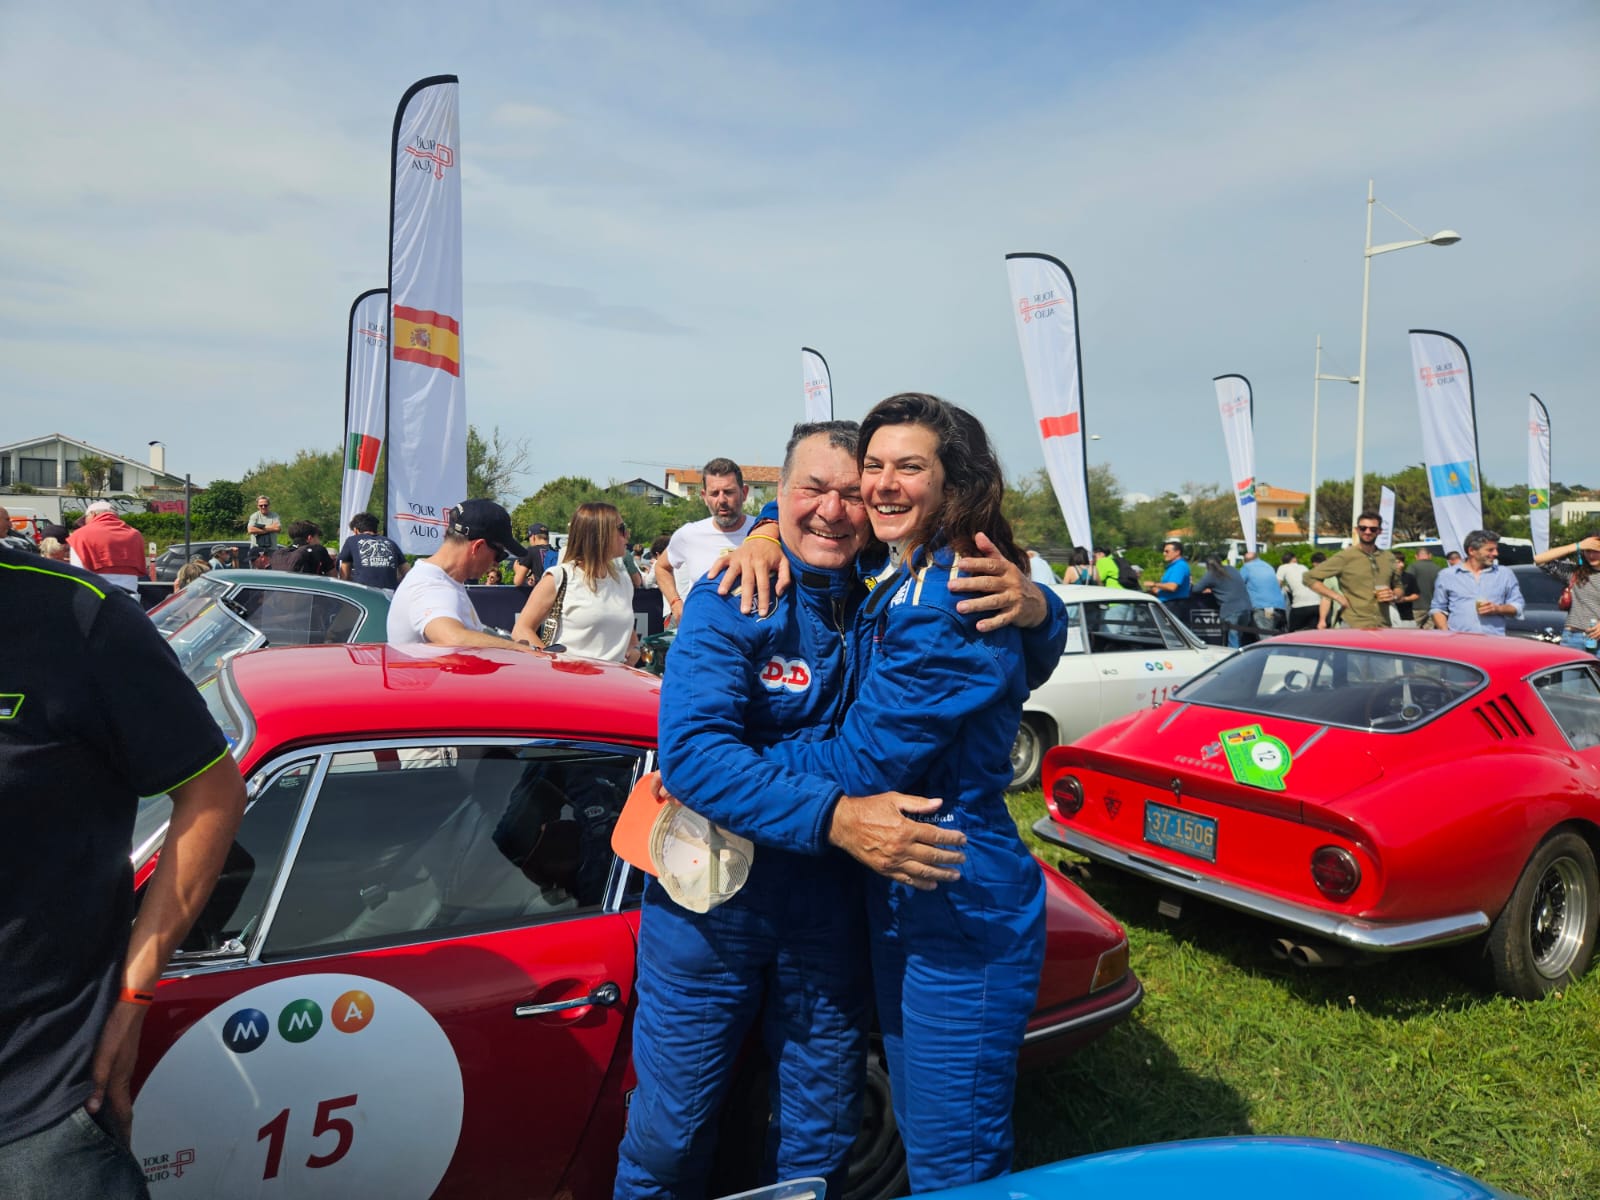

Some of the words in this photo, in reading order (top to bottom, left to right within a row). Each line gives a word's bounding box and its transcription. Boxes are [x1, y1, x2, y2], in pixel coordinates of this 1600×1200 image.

[408, 503, 436, 516] TOUR
[410, 525, 438, 538] AUTO
[257, 1093, 358, 1181] 15
[143, 1153, 169, 1167] TOUR
